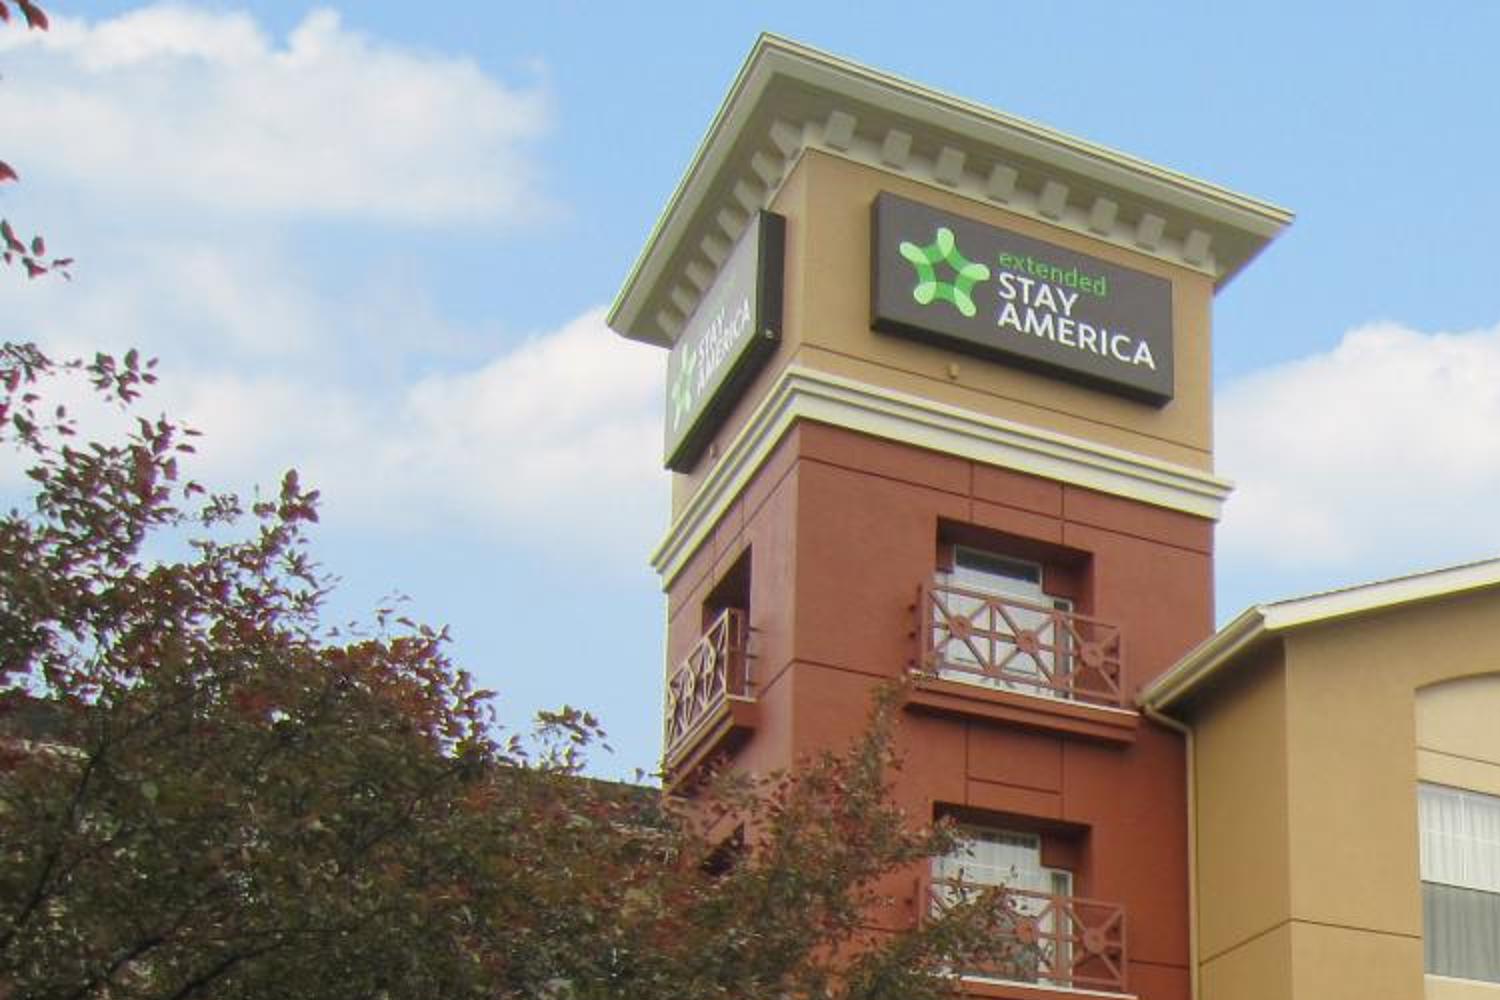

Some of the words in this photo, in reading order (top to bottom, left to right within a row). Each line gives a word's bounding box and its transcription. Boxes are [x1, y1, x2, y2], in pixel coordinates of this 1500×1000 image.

[998, 253, 1107, 297] extended
[998, 271, 1079, 317] STAY
[997, 302, 1156, 370] AMERICA
